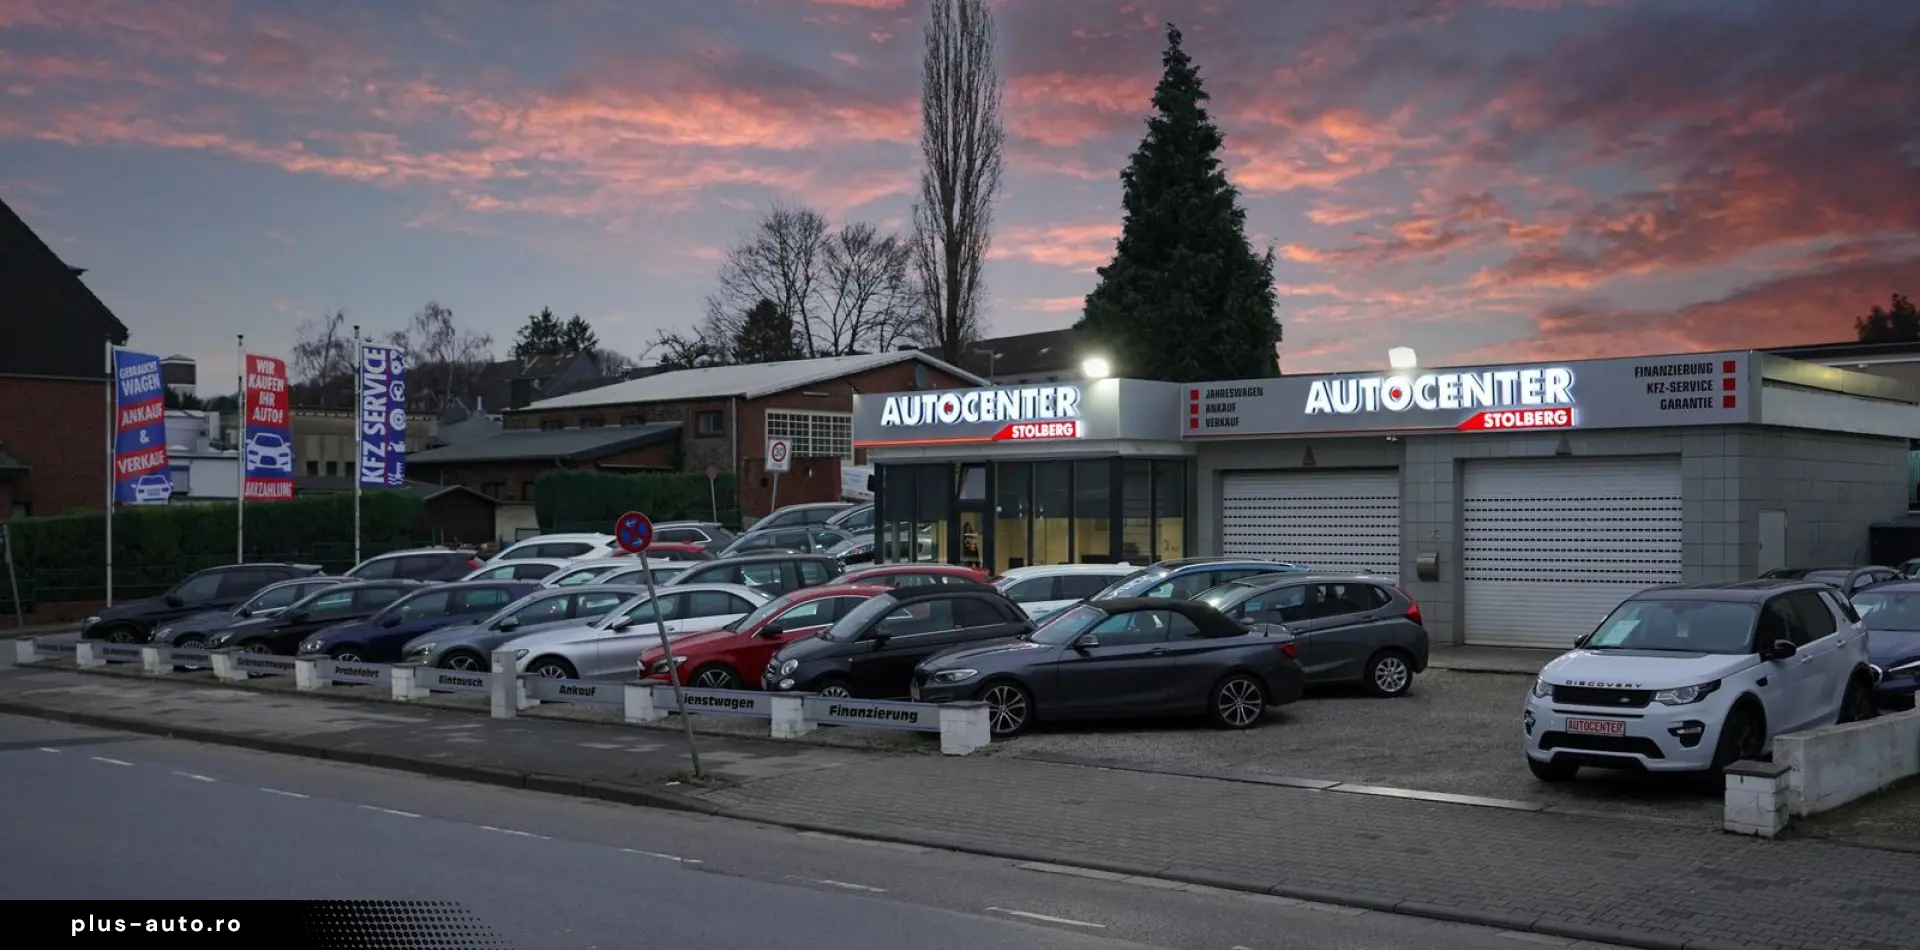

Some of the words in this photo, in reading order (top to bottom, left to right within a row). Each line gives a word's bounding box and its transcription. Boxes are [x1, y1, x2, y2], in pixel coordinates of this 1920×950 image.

[256, 358, 276, 375] WIR
[1634, 362, 1714, 378] FINANZIERUNG
[120, 372, 161, 396] WAGEN
[248, 373, 285, 392] KAUFEN
[363, 347, 387, 435] SERVICE
[1304, 367, 1574, 415] AUTOCENTER
[1646, 379, 1714, 395] KFZ-SERVICE
[259, 390, 276, 407] IHR
[1205, 386, 1263, 400] JAHRESWAGEN
[880, 386, 1081, 427] AUTOCENTER
[1205, 402, 1237, 414] ANKAUF
[1659, 396, 1714, 411] GARANTIE
[121, 402, 163, 426] ANKAUF
[252, 406, 284, 423] AUTO!
[1483, 409, 1568, 429] STOLBERG
[1011, 422, 1074, 439] STOLBERG
[1205, 417, 1240, 429] VERKAUF
[139, 429, 150, 444] &
[117, 450, 165, 474] VERKAUF
[361, 440, 386, 483] KFZ
[335, 666, 380, 679] Probefahrt
[439, 674, 483, 688] Eintausch
[559, 684, 596, 697] Ankauf
[1565, 679, 1643, 689] DISCOVERY
[676, 694, 755, 710] ienstwagen
[829, 704, 918, 723] Finanzierung
[1568, 720, 1623, 734] AUTOCENTER
